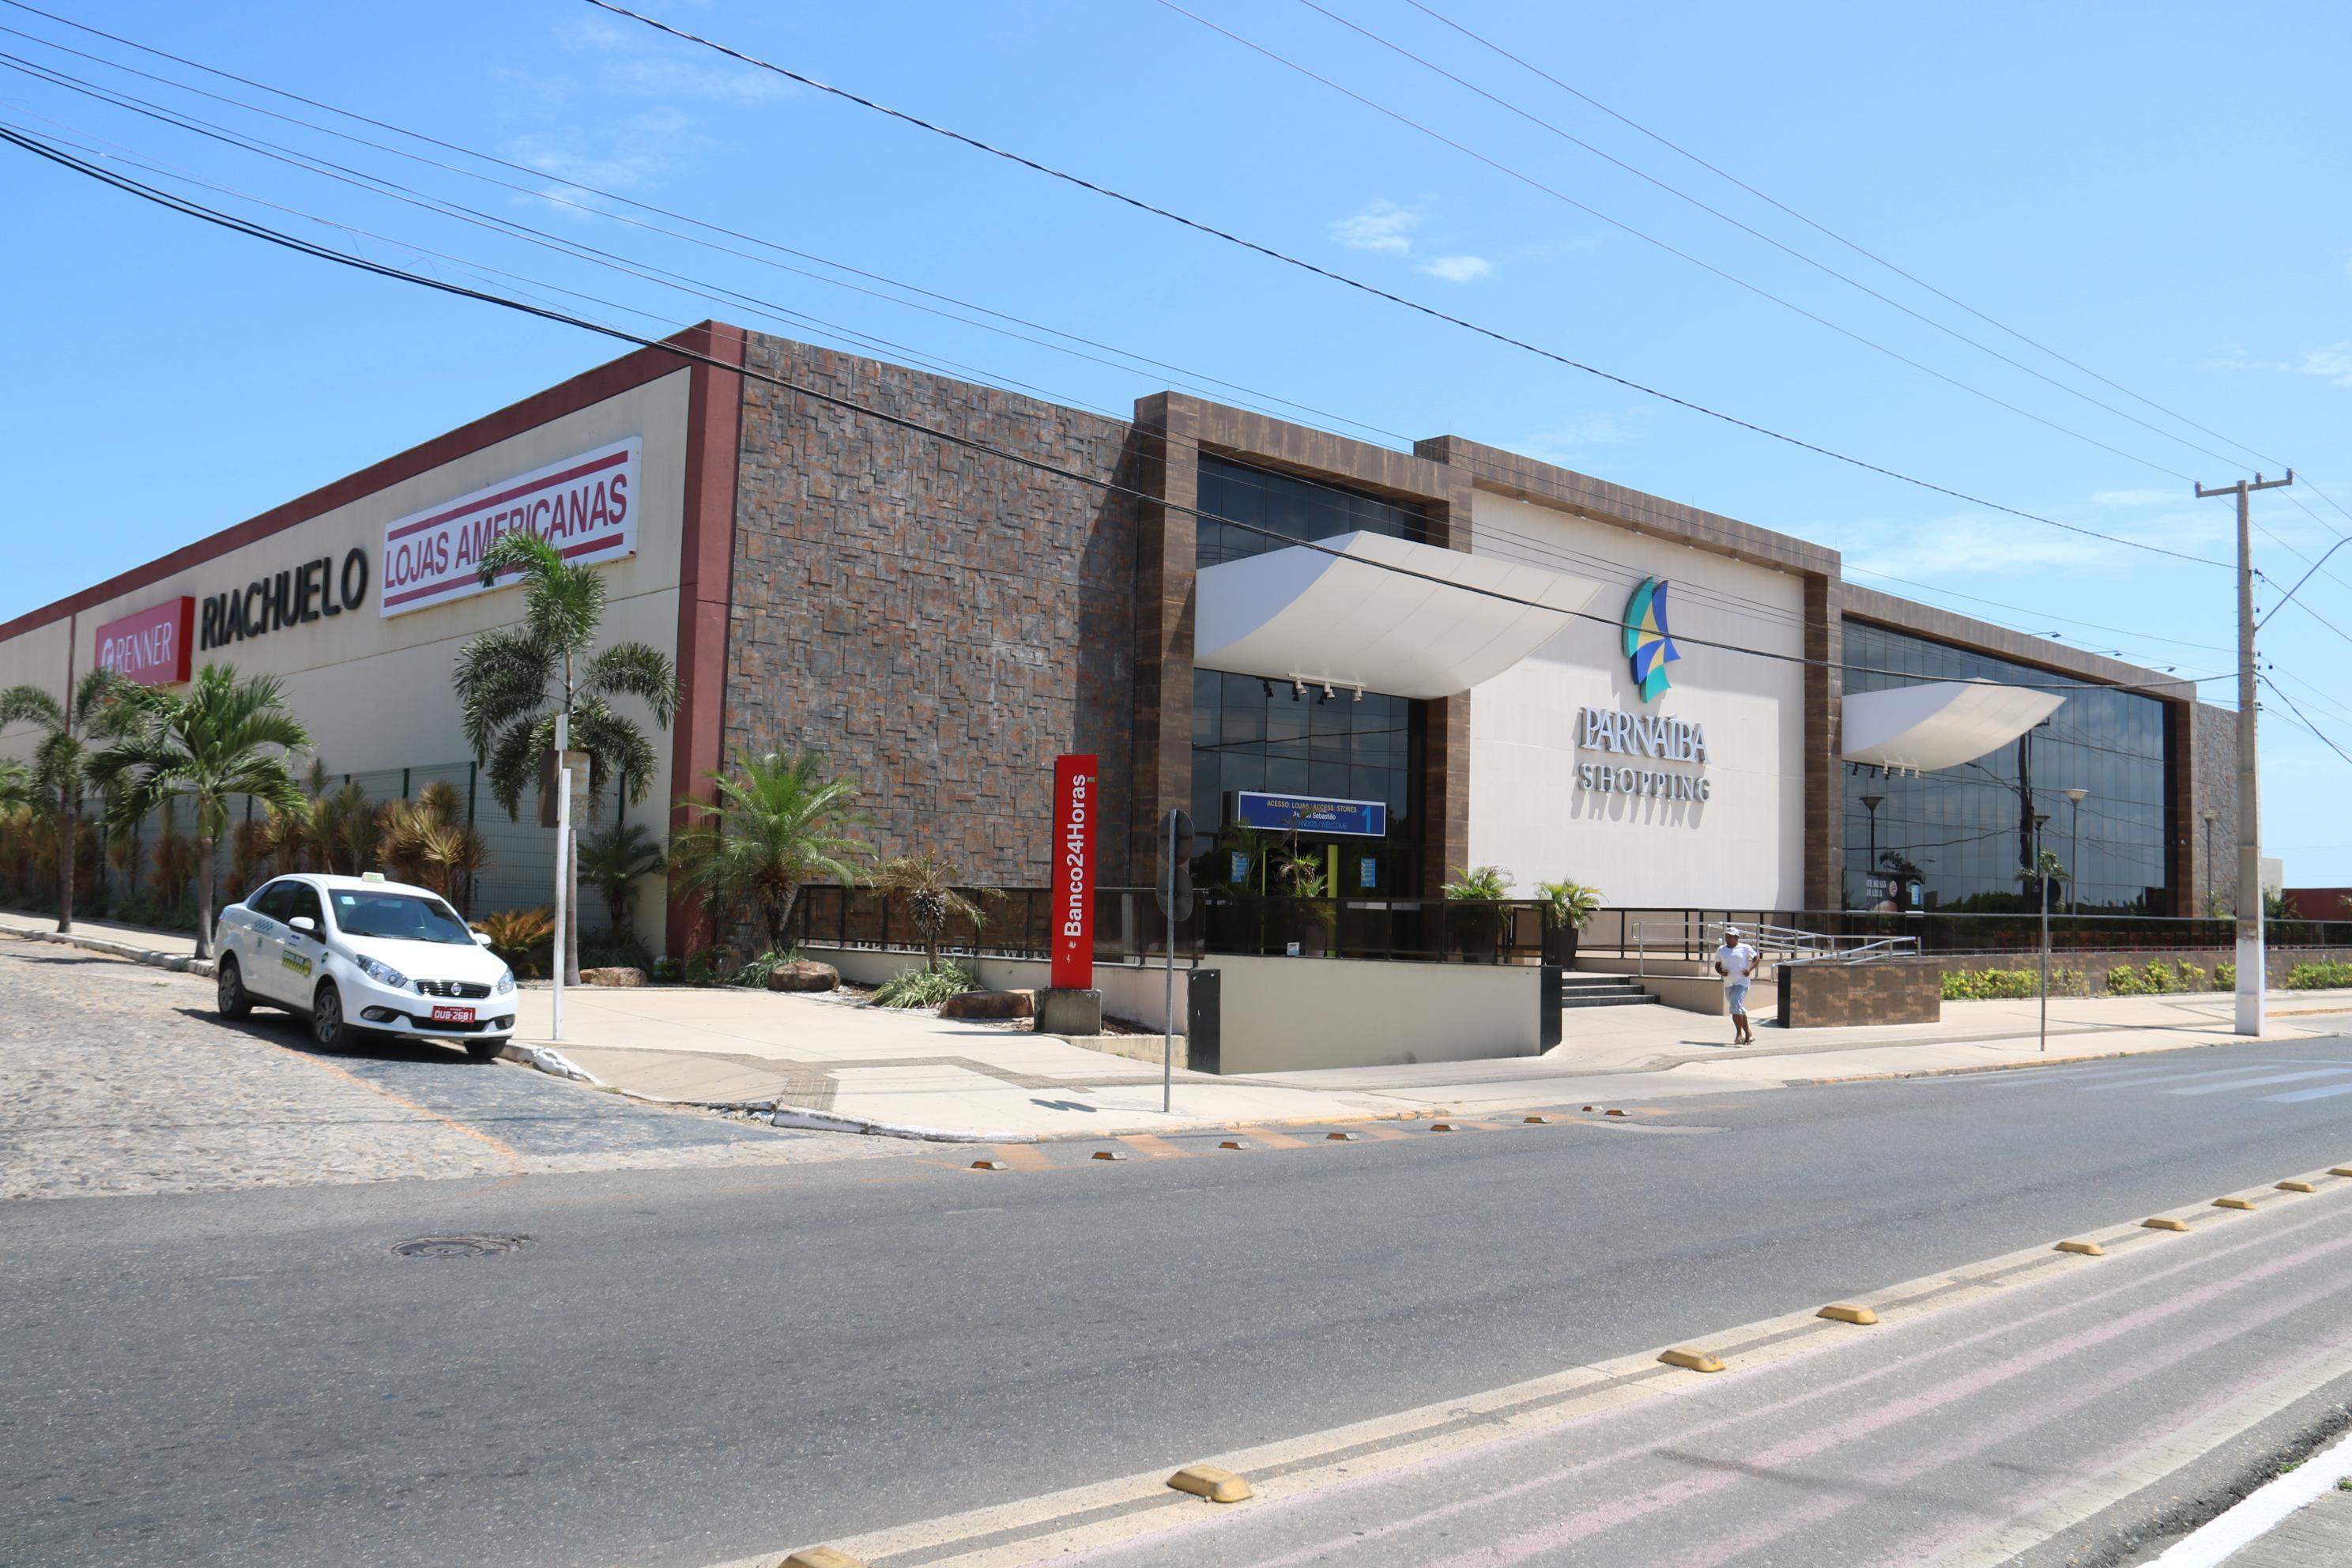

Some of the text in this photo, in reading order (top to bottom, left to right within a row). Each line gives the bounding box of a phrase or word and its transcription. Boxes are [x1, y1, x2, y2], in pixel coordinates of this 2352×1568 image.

[384, 531, 449, 589] LOJAS
[201, 548, 369, 650] RIACHUELO
[115, 622, 172, 674] RENNER
[1579, 707, 1712, 765] PARNAÍBA
[1267, 800, 1291, 808] ACESSO:
[1578, 763, 1712, 803] SHOPPING
[1312, 812, 1336, 820] Sebastião
[1362, 805, 1371, 835] 1
[1064, 774, 1087, 937] Banco24Horas
